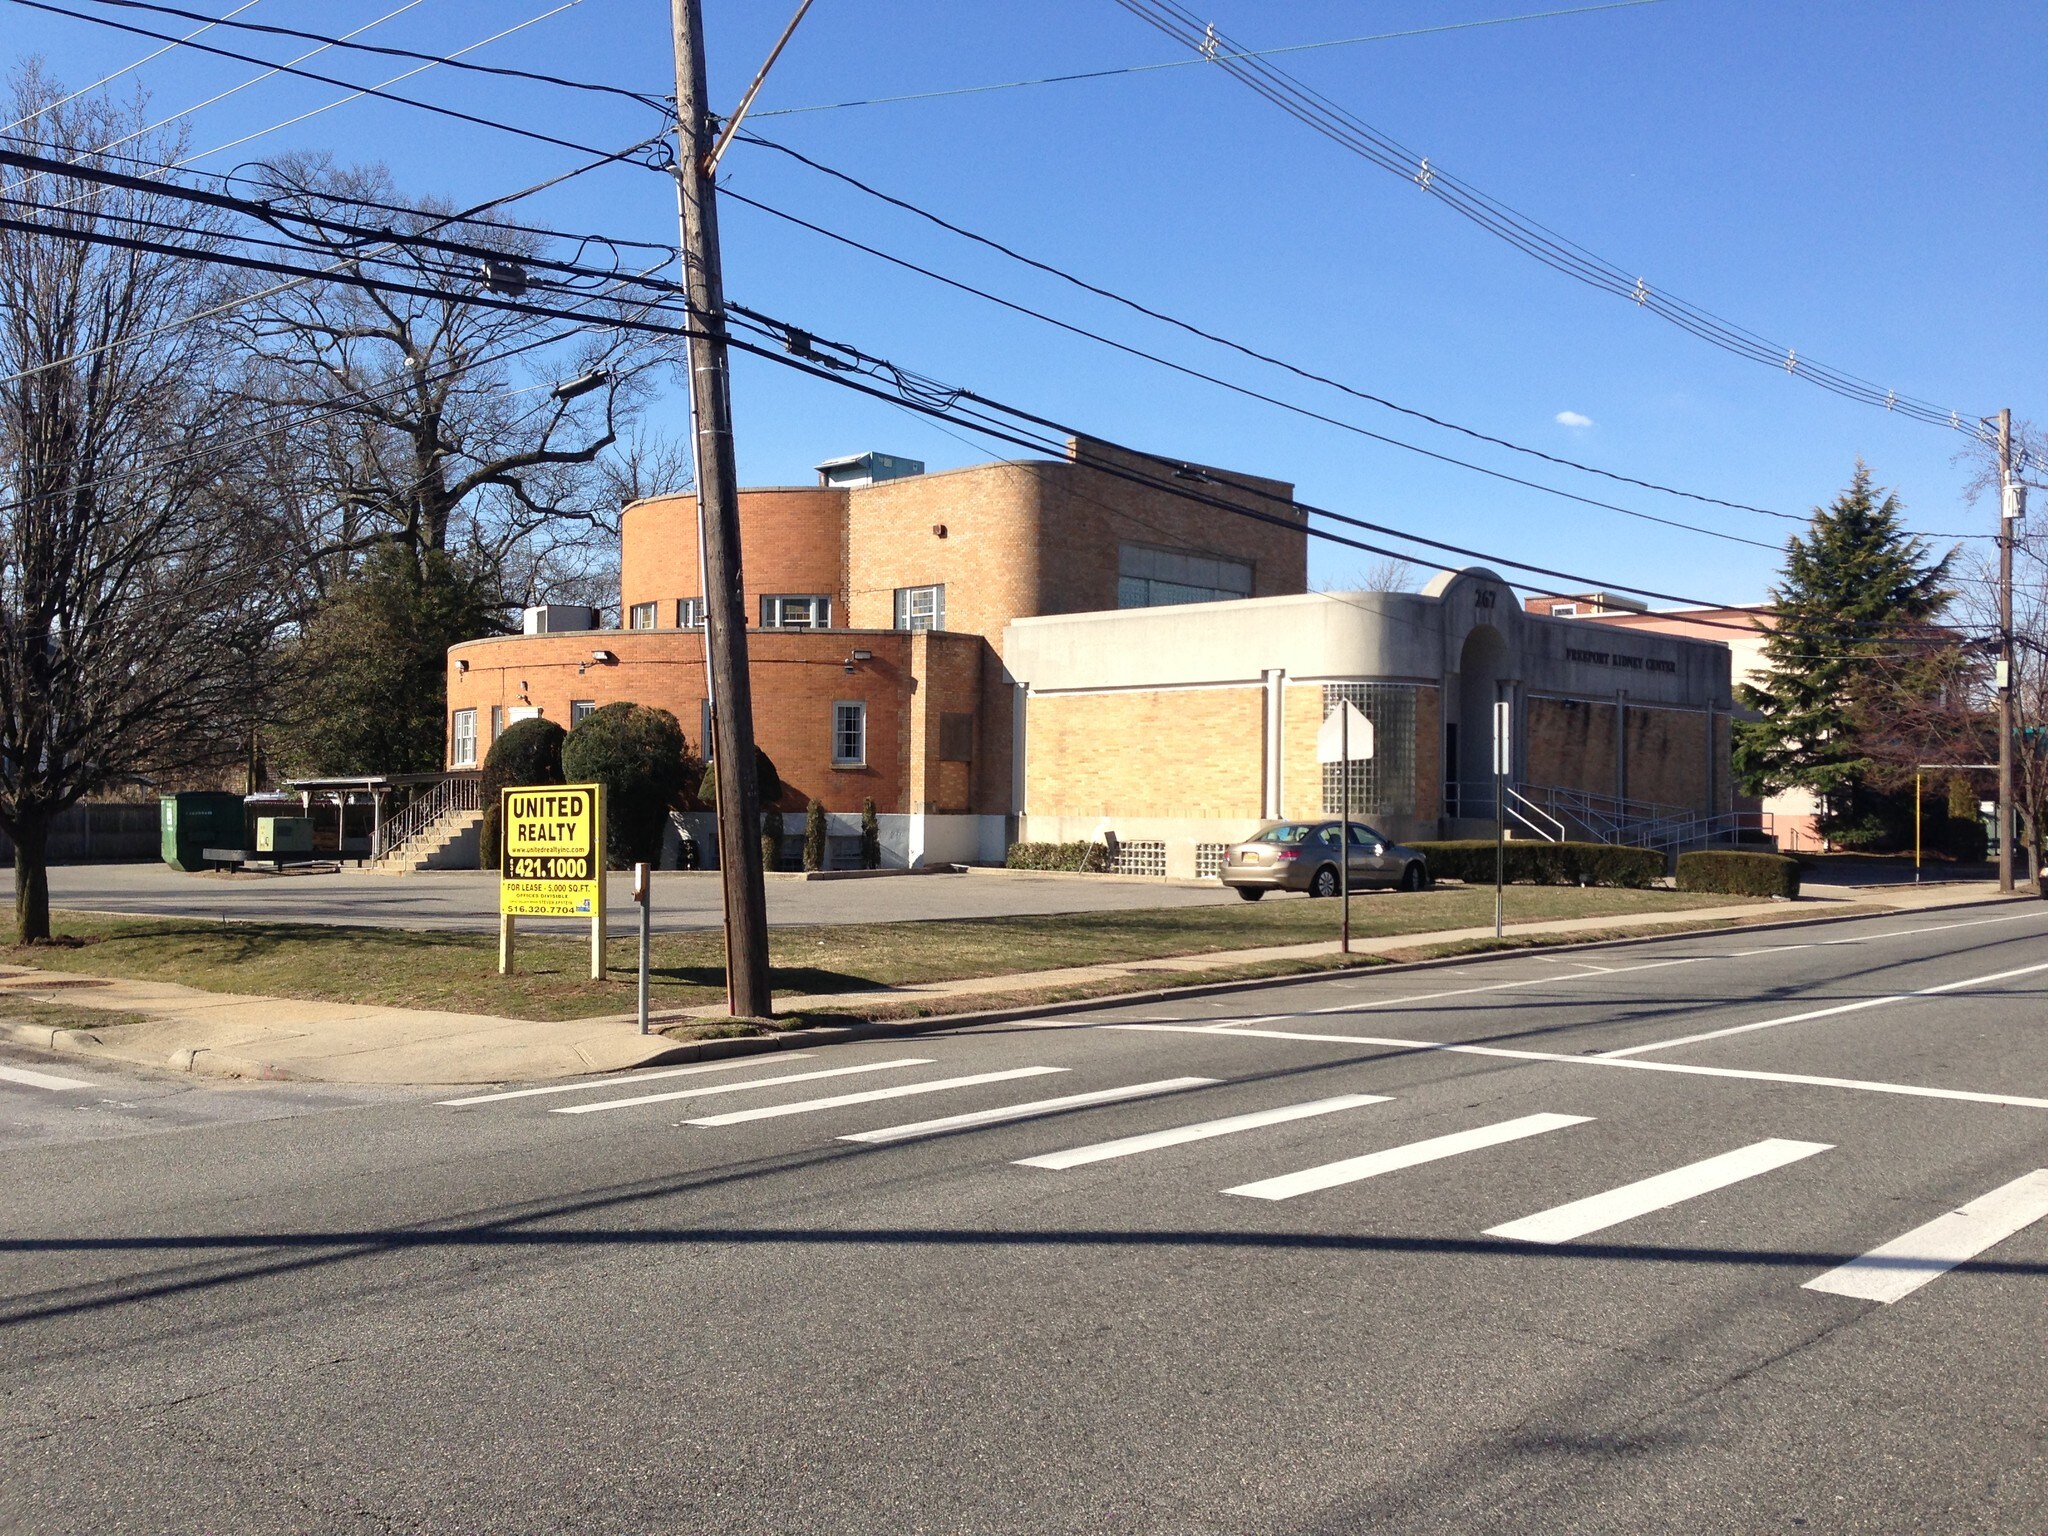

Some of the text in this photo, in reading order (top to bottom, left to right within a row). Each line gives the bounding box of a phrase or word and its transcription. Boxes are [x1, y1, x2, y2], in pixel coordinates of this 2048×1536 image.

[1475, 588, 1497, 608] 267
[1566, 648, 1675, 672] FREEPORT KIDNEY CENTER
[513, 796, 583, 818] UNITED
[518, 823, 576, 841] REALTY
[512, 846, 585, 854] www.unitedrealtyinc.com
[515, 858, 587, 878] 421.1000
[507, 883, 520, 891] FOR
[521, 883, 542, 892] LEASE
[548, 884, 566, 892] 5,000
[507, 905, 575, 913] 516.320.7704
